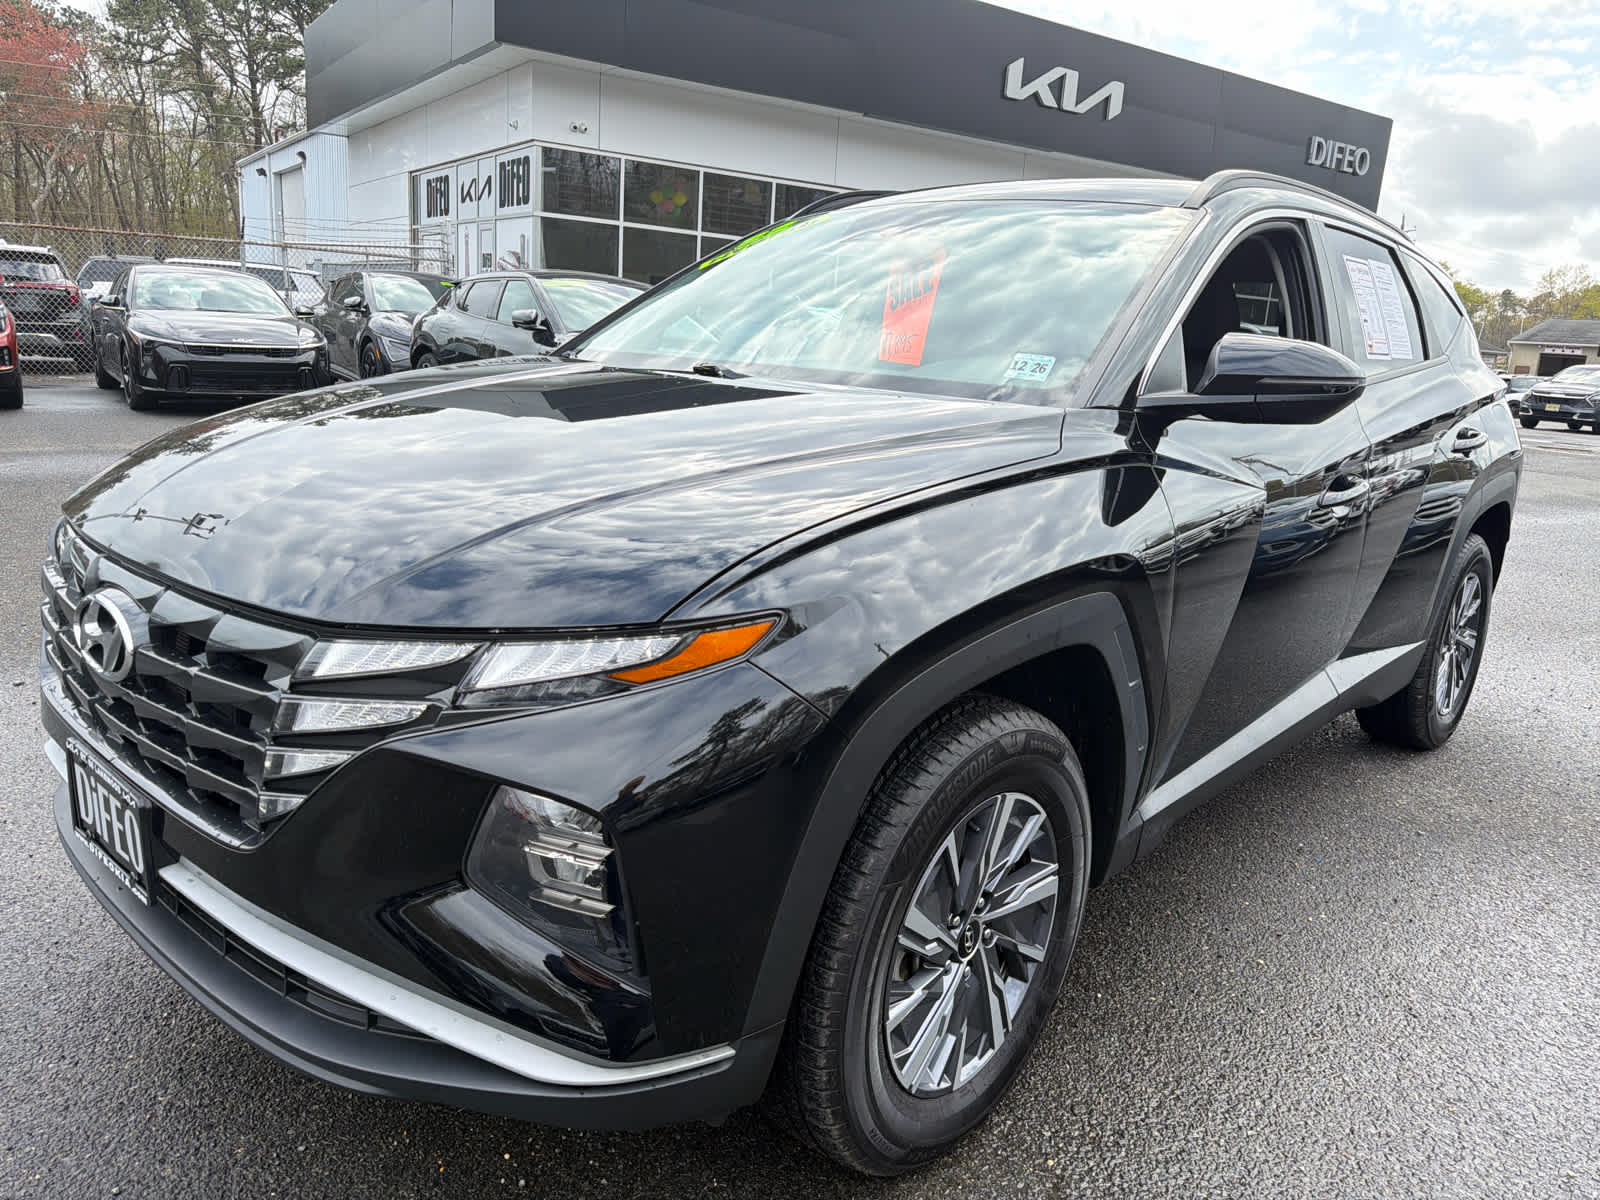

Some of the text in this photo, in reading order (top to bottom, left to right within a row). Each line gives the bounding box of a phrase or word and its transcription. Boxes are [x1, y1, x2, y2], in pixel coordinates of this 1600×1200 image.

[1004, 57, 1125, 121] KIA
[1308, 135, 1370, 176] DIFEO
[460, 175, 492, 204] KIA
[1030, 362, 1049, 374] 26
